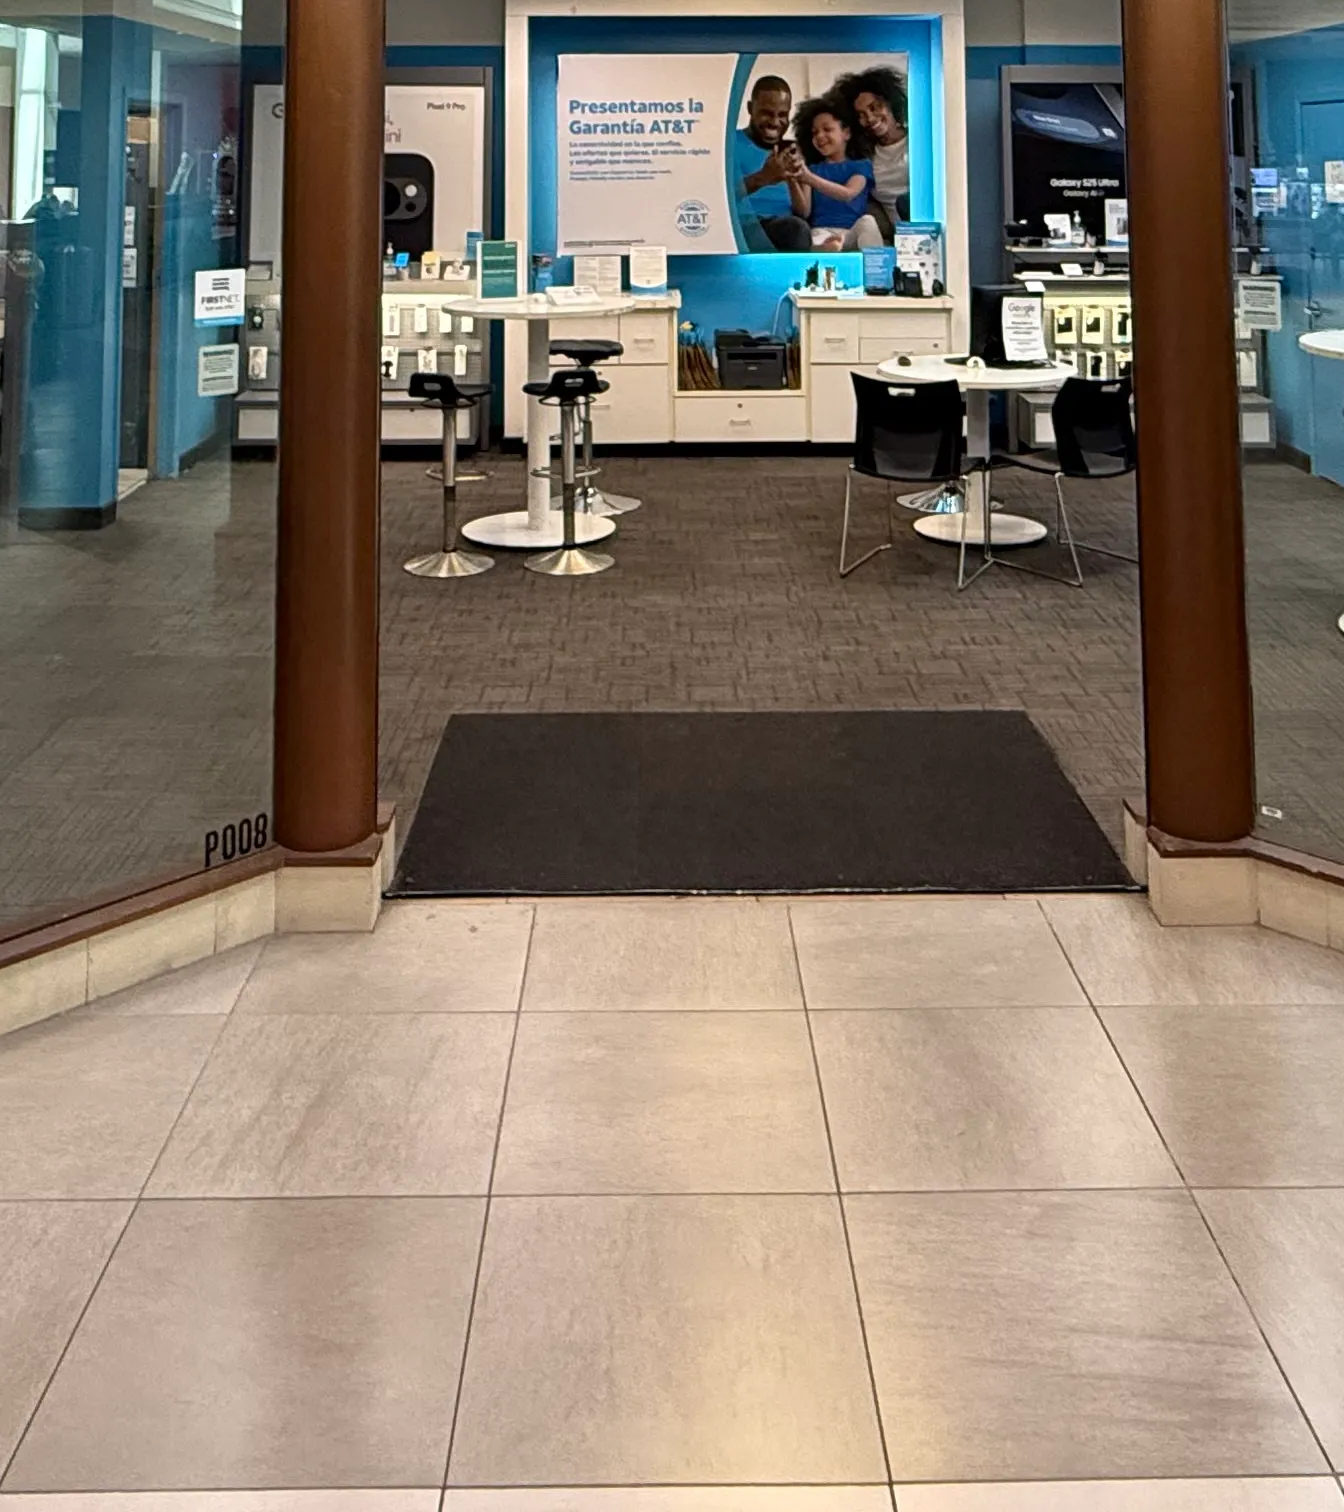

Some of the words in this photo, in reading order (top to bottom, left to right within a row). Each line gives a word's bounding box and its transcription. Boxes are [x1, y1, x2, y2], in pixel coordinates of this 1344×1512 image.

[568, 99, 684, 114] Presentamos
[689, 97, 704, 113] la
[568, 119, 645, 135] Garantía
[1049, 178, 1081, 188] Galaxy
[676, 213, 709, 225] AT&T
[204, 812, 268, 867] P008
